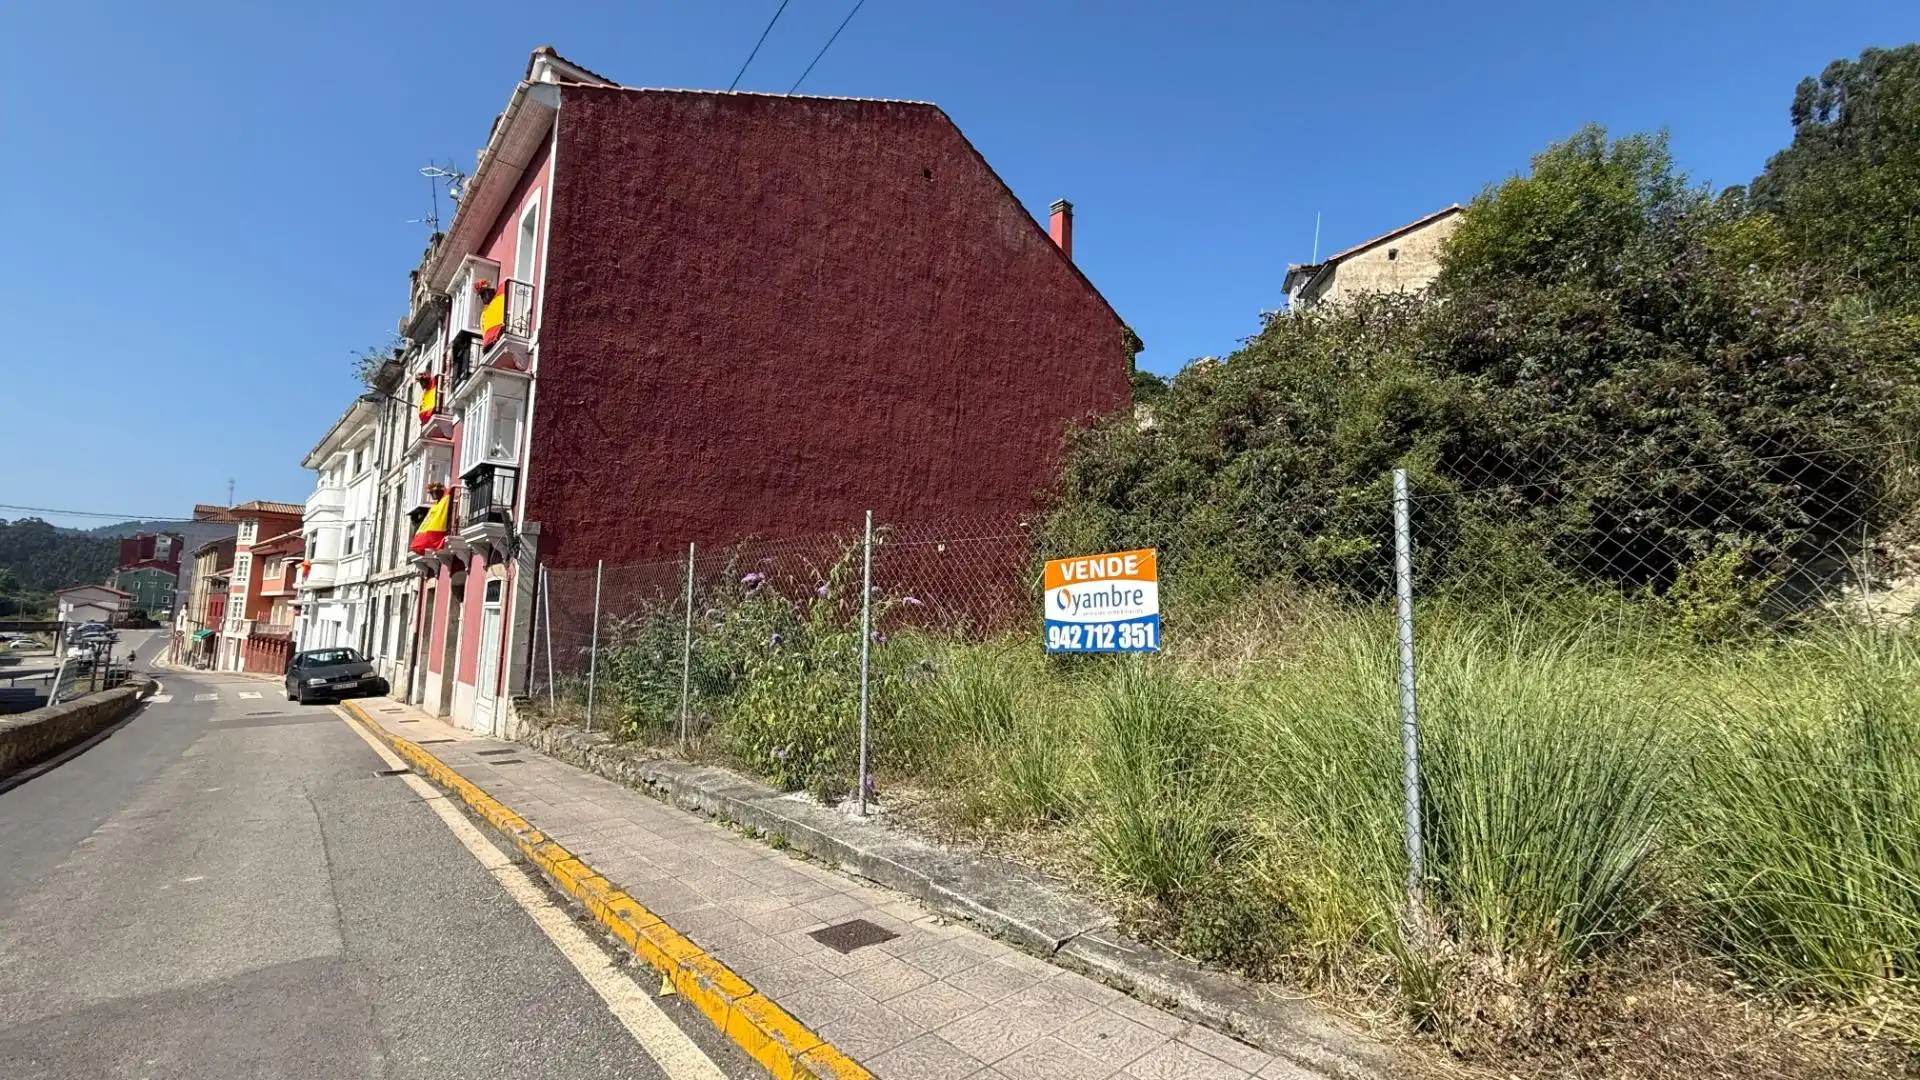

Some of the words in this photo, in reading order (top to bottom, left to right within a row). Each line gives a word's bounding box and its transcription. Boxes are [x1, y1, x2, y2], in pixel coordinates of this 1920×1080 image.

[1060, 554, 1139, 581] VENDE
[1056, 584, 1144, 616] Oyambre
[1048, 625, 1082, 649] 942
[1084, 624, 1115, 649] 712
[1118, 622, 1154, 649] 351
